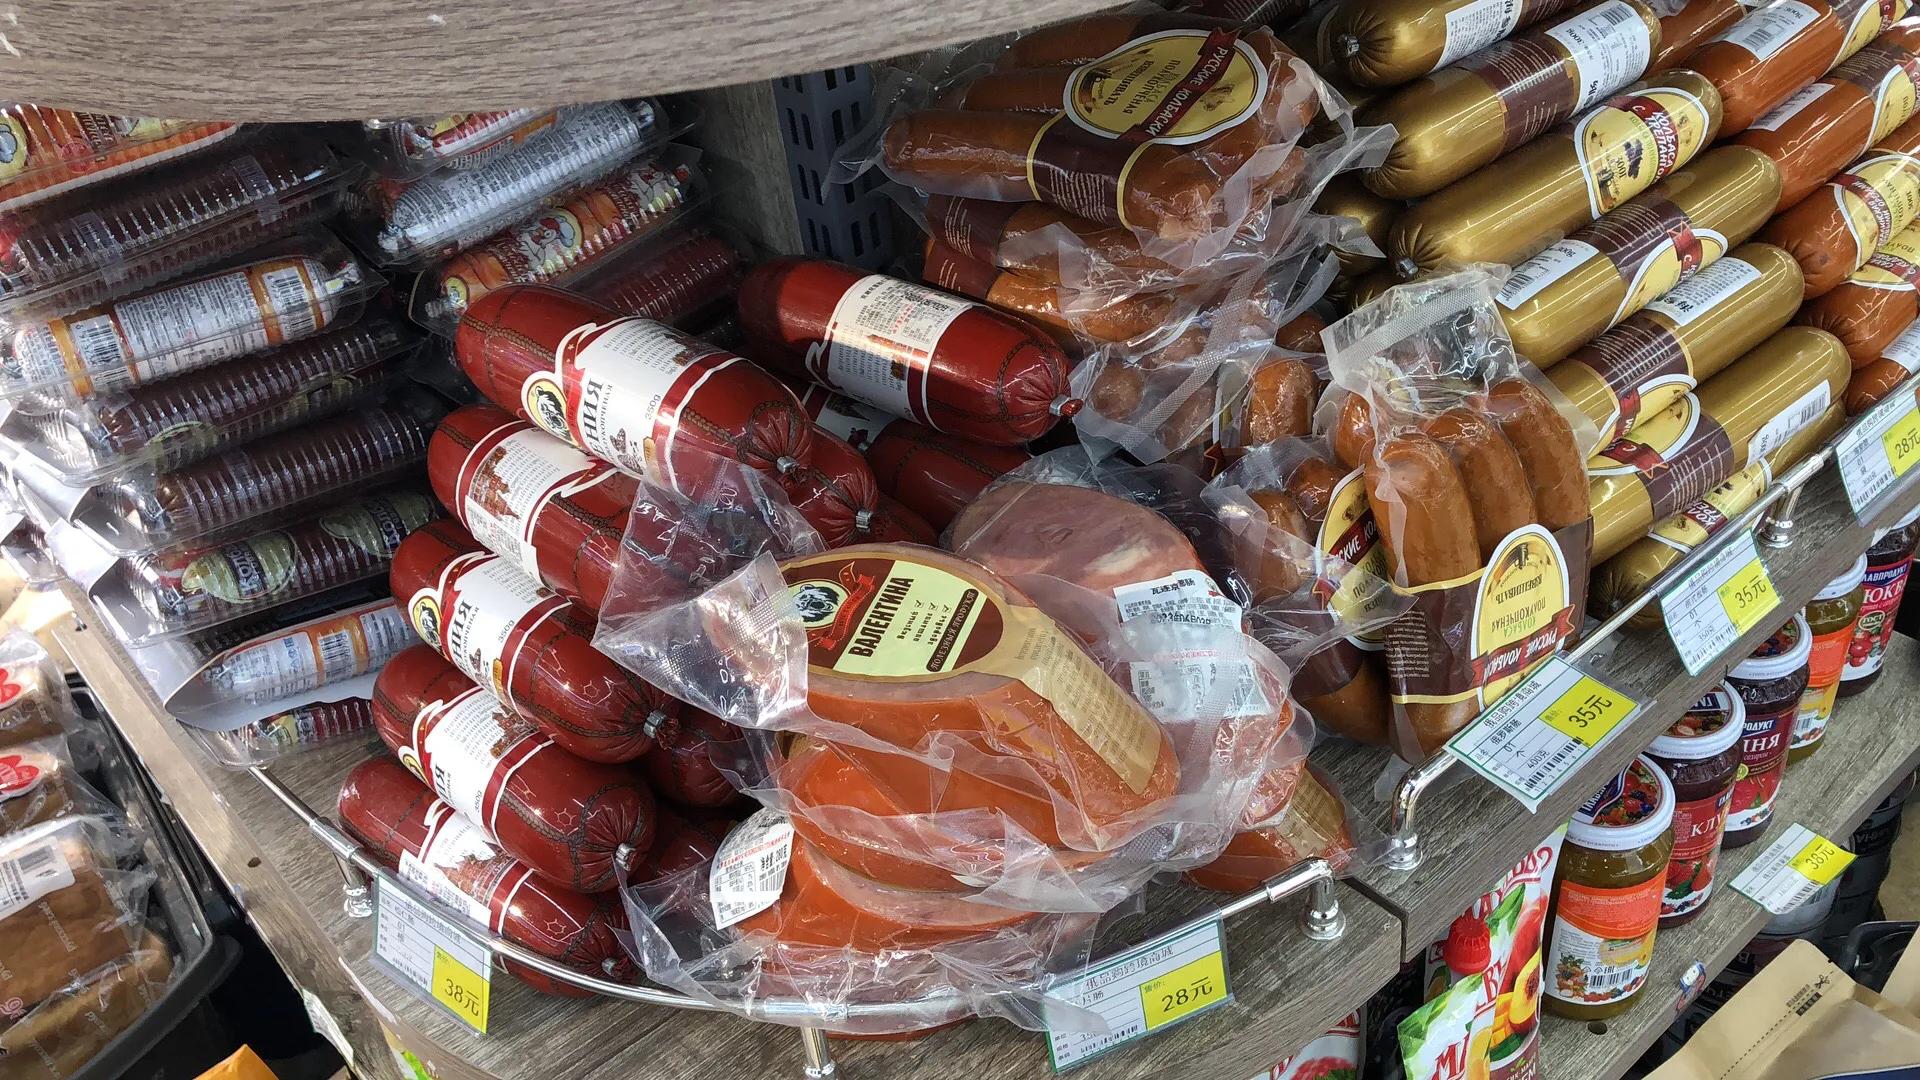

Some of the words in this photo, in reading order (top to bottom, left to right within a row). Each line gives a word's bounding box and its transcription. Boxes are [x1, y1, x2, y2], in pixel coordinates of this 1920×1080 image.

[1190, 45, 1228, 88] РУССКИЕ
[1121, 58, 1181, 117] ПОЛУКОПЧЕНАЯ
[1144, 86, 1192, 137] КОЛБАСКИ
[1652, 110, 1676, 167] КОЛБАСА
[1895, 428, 1920, 459] 28元
[1735, 576, 1766, 608] 35元
[848, 575, 915, 658] ВАЛЕНТИНА
[930, 626, 957, 669] ПОЛЕЗНЫЙ
[950, 590, 976, 627] ПРОДУКТ
[1491, 597, 1546, 633] ПОЛУКОПЧЕНАЯ
[1504, 617, 1537, 637] КОЛБАСА
[1525, 627, 1559, 657] РУССКИЕ
[1568, 694, 1613, 728] 35元
[1491, 718, 1522, 746] 俄罗斯肠
[1503, 743, 1516, 753] 01
[1515, 750, 1527, 758] 个
[1527, 750, 1550, 768] 400克
[1805, 844, 1836, 870] 38元
[445, 979, 480, 1017] 38元
[1162, 976, 1213, 1012] 28元
